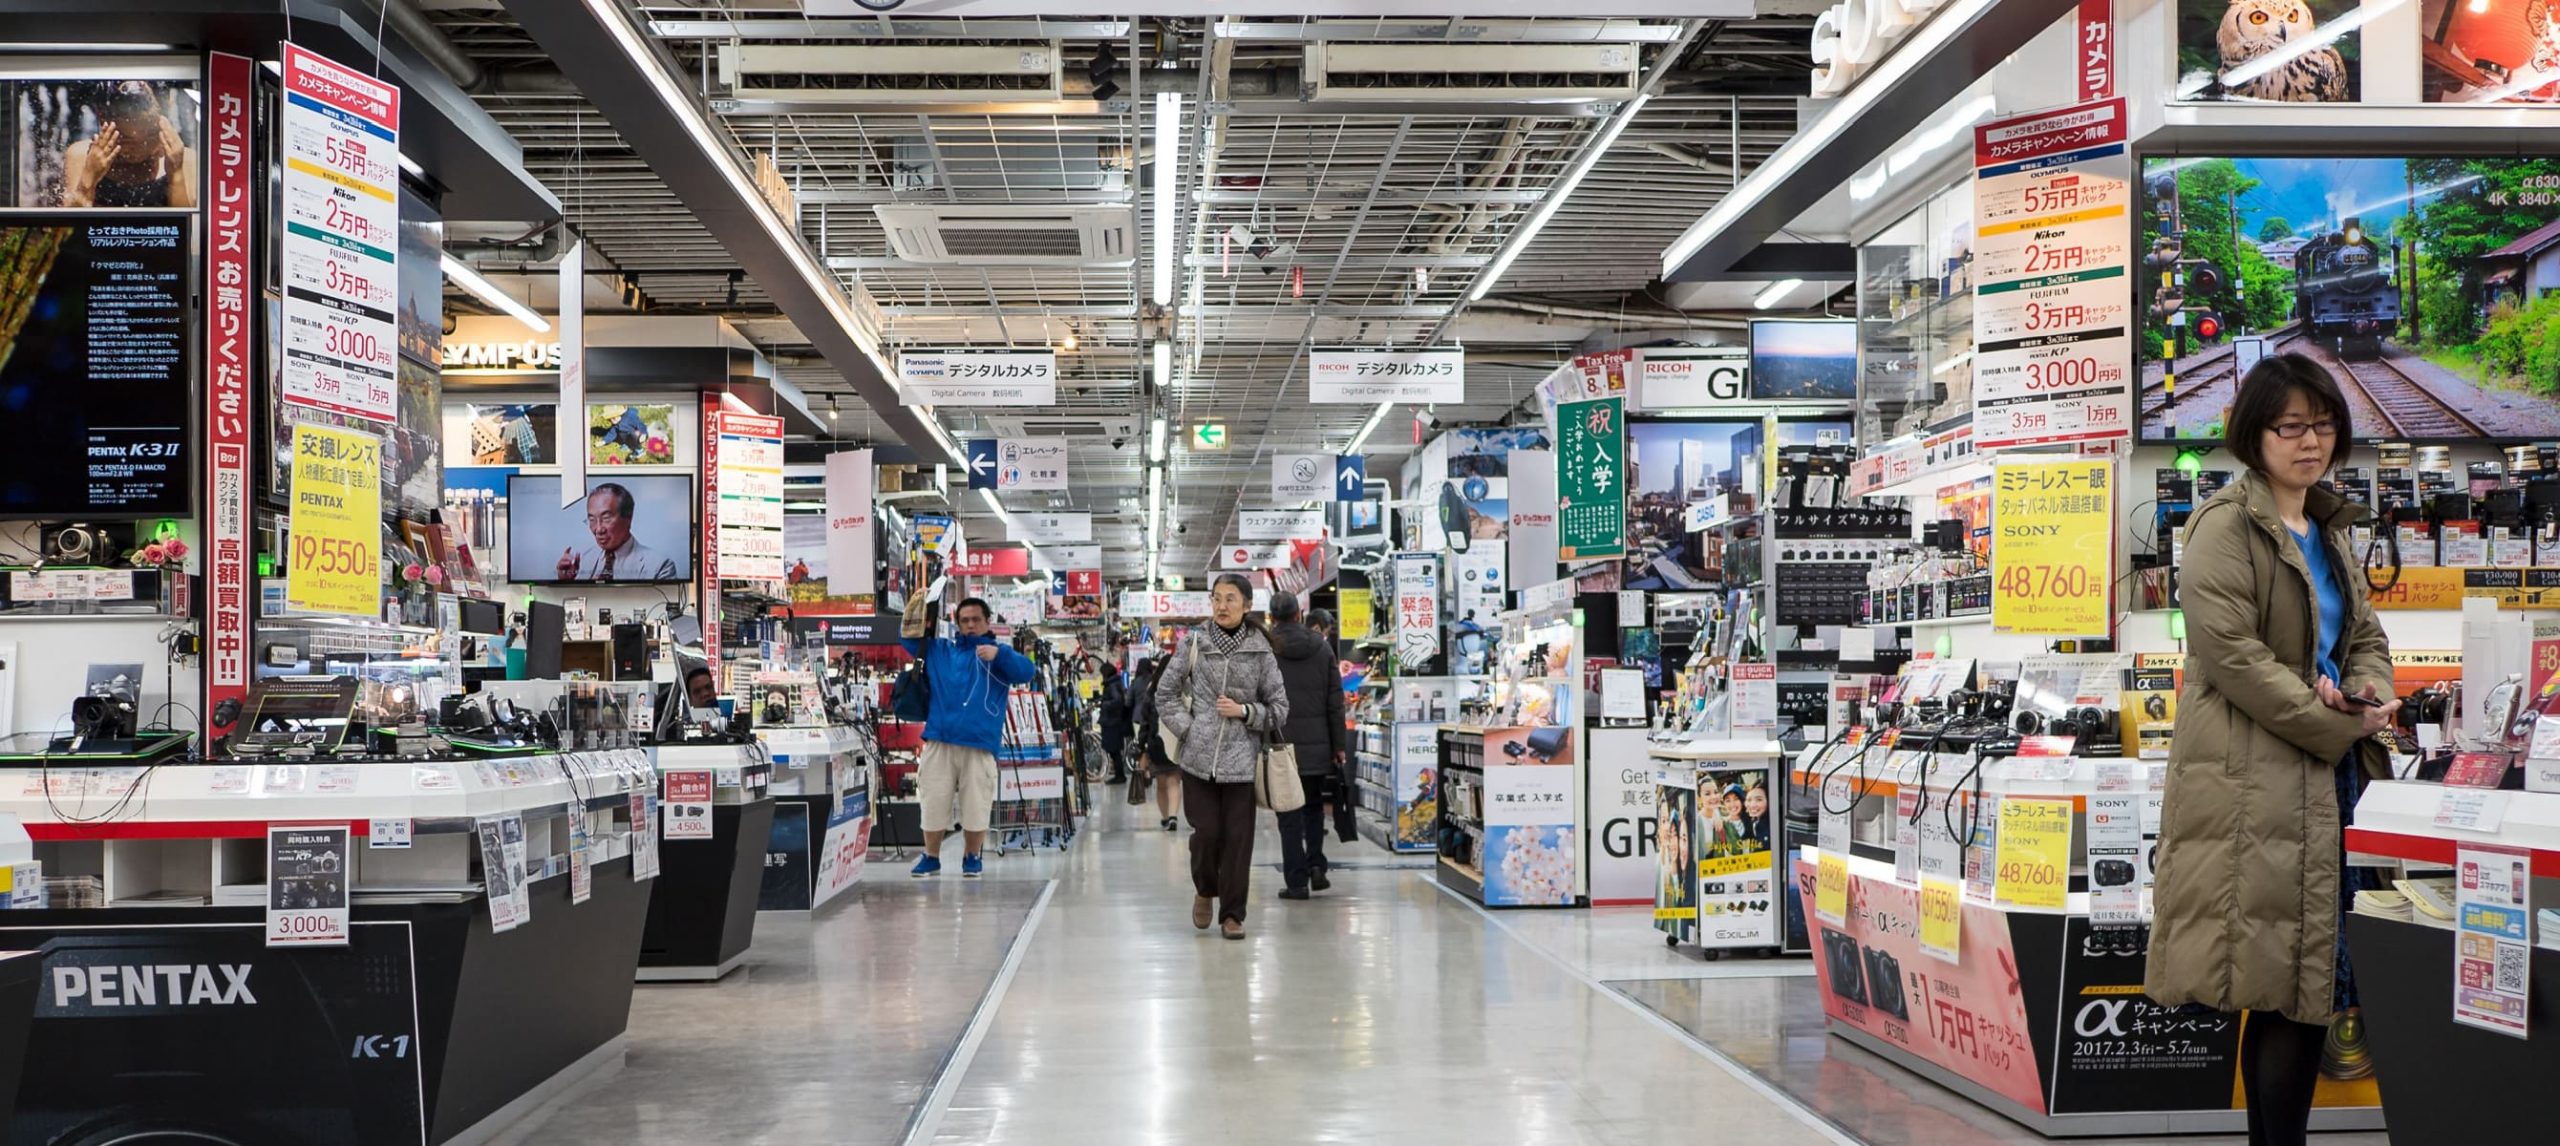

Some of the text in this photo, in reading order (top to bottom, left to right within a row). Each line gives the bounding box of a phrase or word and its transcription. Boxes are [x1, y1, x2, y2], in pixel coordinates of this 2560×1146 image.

[298, 74, 387, 118] カメラキャンペーン情報
[1990, 125, 2109, 157] カメラキャンペーン情報
[326, 136, 366, 176] 5万円
[2030, 167, 2070, 179] OLYMPUS
[333, 186, 356, 202] Nikon
[2081, 181, 2124, 194] キャッシュ
[2024, 187, 2078, 213] 5万円
[2488, 192, 2508, 206] 4K
[326, 198, 368, 240] 2万円
[2034, 230, 2066, 241] Nikon
[216, 93, 242, 438] カメラ・レンズ お売りください
[2024, 244, 2083, 274] 2万円
[326, 260, 368, 300] 3万円
[2030, 287, 2069, 300] FUJIFILM
[2025, 303, 2084, 331] 3万円
[2050, 347, 2070, 357] KP
[906, 358, 945, 366] Panasonic
[1585, 354, 1626, 366] Tax Free
[948, 364, 1048, 378] デジタルカメラ
[1356, 362, 1453, 376] デジタルカメラ
[1646, 364, 1692, 374] RICOH
[1982, 366, 2022, 376] 同時購入特典
[314, 371, 340, 394] 3万円
[368, 382, 389, 405] 1万円
[932, 389, 955, 398] Digital
[1342, 387, 1365, 396] Digital
[1982, 408, 2008, 416] SONY
[2086, 405, 2117, 421] 1万円
[1588, 408, 1613, 434] 祝
[2012, 412, 2046, 428] 3万円
[88, 447, 126, 456] PENTAX
[130, 443, 164, 456] K-3
[301, 433, 375, 465] 交換レンズ
[1022, 446, 1064, 455] エレベーター
[1574, 410, 1584, 496] ご入学おめでとう
[1592, 442, 1613, 494] 入学
[2002, 468, 2106, 492] ミラーレス一眼
[300, 492, 343, 508] PENTAX
[1696, 504, 1714, 524] CASIO
[1246, 518, 1316, 526] ウェアラブルカメラ
[2004, 525, 2062, 536] SONY
[1252, 552, 1278, 560] LEICA
[1998, 564, 2086, 600] 48,760
[2412, 582, 2456, 592] キャッシュ
[1152, 595, 1170, 612] 15
[1402, 596, 1433, 612] 緊急
[2412, 592, 2439, 602] バック
[1402, 614, 1433, 628] 入荷
[2144, 658, 2178, 666] フルサイズ
[1622, 769, 1650, 784] Get
[1496, 792, 1564, 802] 卒業式 入学式
[2096, 800, 2129, 808] SONY
[2004, 838, 2040, 846] SONY
[1715, 930, 1760, 940] EXILIM
[53, 964, 257, 1007] PENTAX
[1978, 1014, 2026, 1052] キャッシュ
[2132, 1018, 2228, 1035] キャンペーン
[352, 1034, 410, 1058] K-1
[1984, 1045, 2010, 1072] バック
